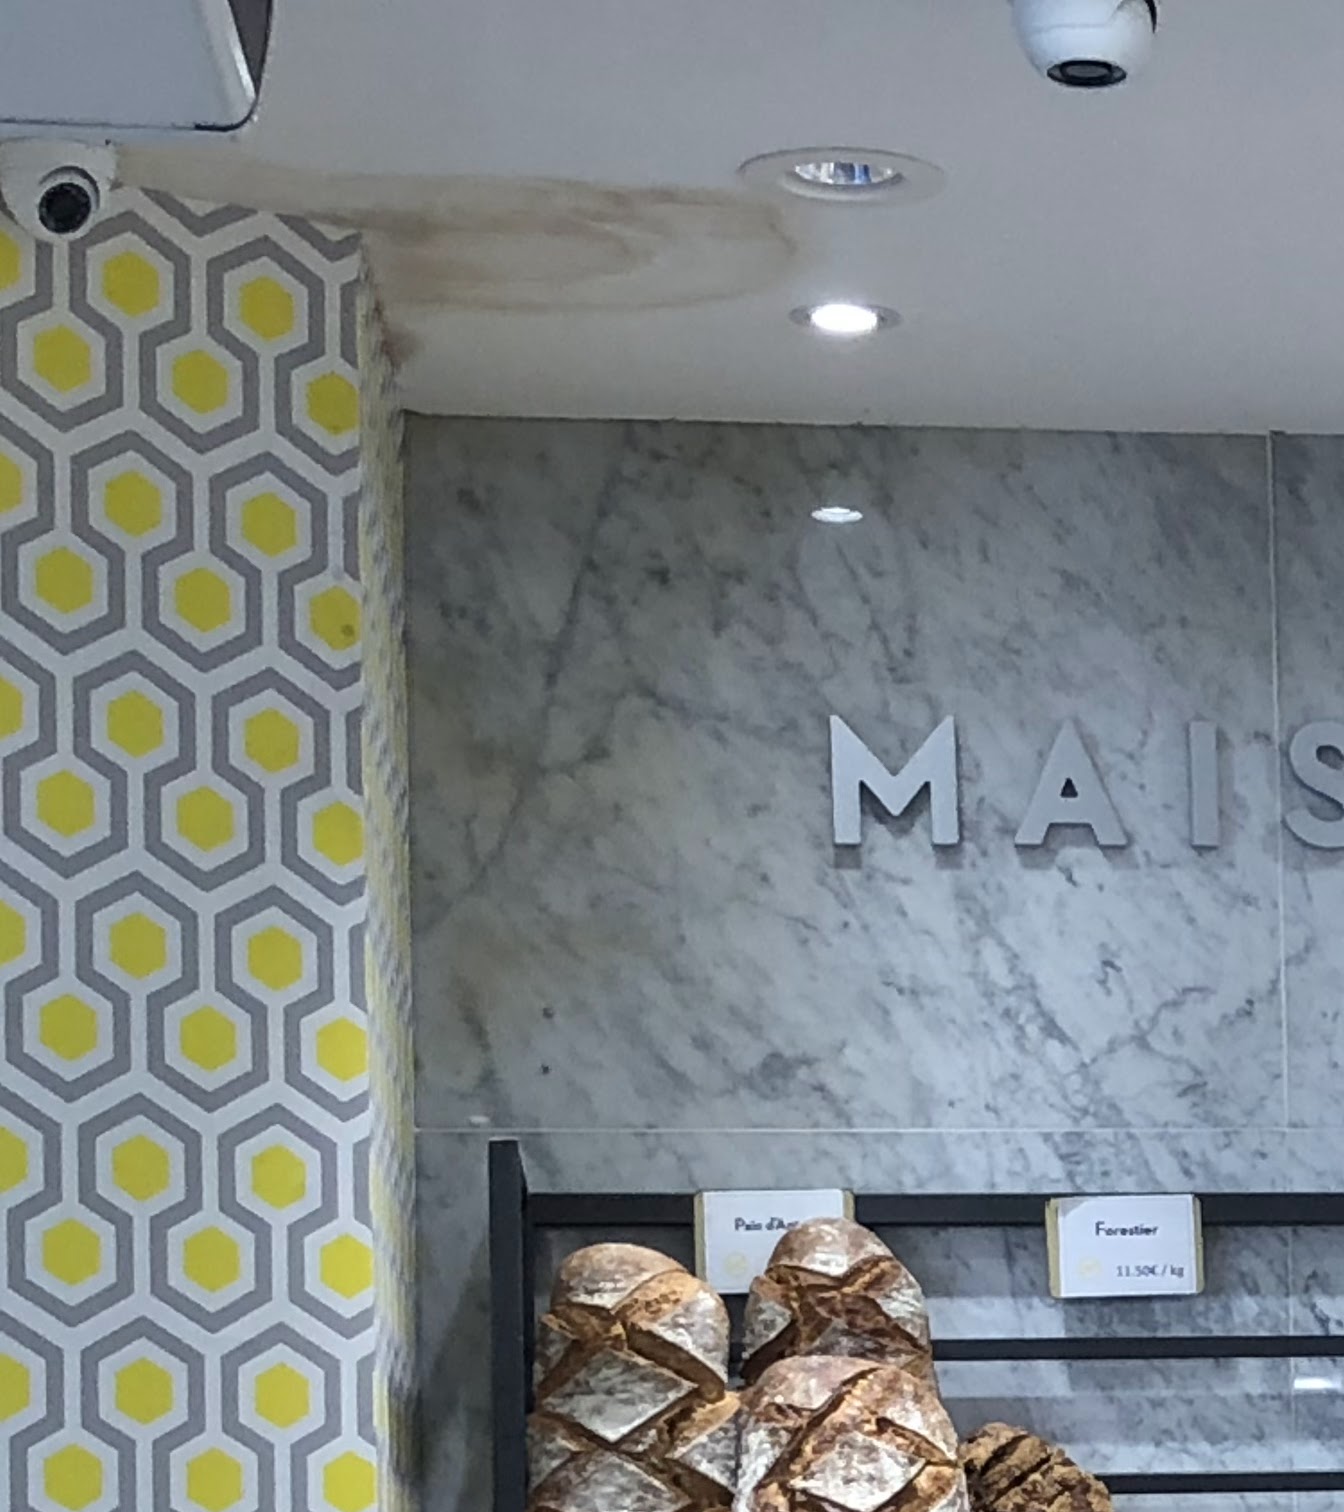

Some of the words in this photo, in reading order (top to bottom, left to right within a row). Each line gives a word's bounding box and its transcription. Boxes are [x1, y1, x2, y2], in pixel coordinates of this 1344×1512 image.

[734, 1217, 763, 1231] Pain
[1095, 1220, 1159, 1237] Forestier
[1170, 1264, 1185, 1279] kg
